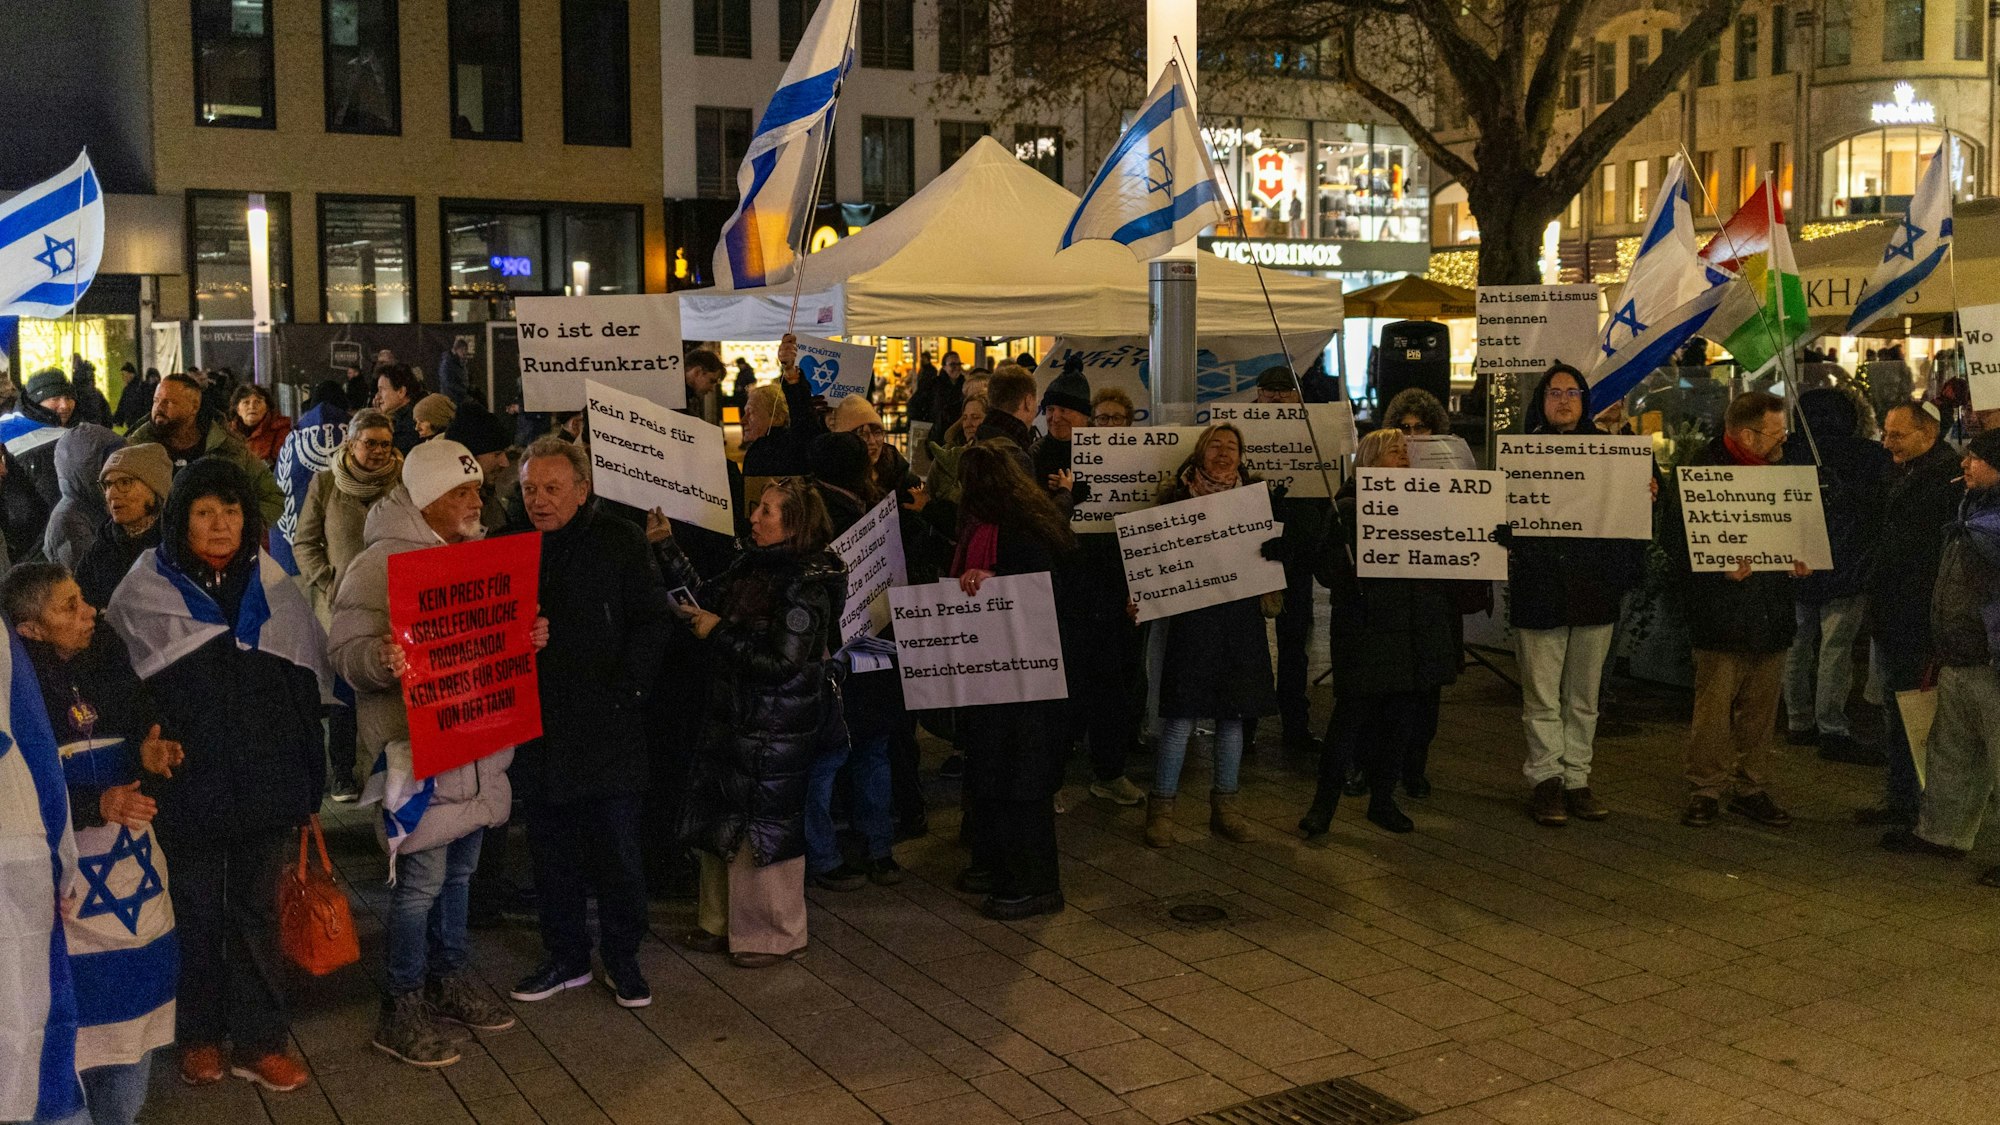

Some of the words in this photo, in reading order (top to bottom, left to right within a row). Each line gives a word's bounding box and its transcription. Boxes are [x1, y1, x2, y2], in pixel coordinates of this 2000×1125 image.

[1211, 241, 1343, 266] VICTORINOX
[1479, 291, 1598, 303] Antisemitismus
[1479, 314, 1548, 325] benennen
[520, 323, 549, 339] Wo
[557, 322, 593, 338] ist
[601, 322, 640, 337] der
[1964, 329, 1993, 345] Wo
[1479, 335, 1522, 346] statt
[808, 346, 842, 359] SCHÜTZEN
[523, 355, 680, 373] Rundfunkrat?
[1479, 357, 1547, 368] belohnen
[1968, 361, 2000, 376] Ru
[831, 381, 866, 393] JÜDISCHES
[588, 398, 625, 421] Kein
[629, 410, 667, 435] Preis
[670, 428, 695, 444] für
[1212, 408, 1237, 420] Ist
[1243, 408, 1271, 420] die
[1276, 409, 1309, 420] ARD
[592, 429, 665, 460] verzerrte
[1073, 433, 1102, 446] Ist
[1108, 433, 1137, 446] die
[1143, 432, 1179, 446] ARD
[1500, 442, 1652, 456] Antisemitismus
[1073, 452, 1104, 465] die
[594, 454, 728, 510] Berichterstattung
[1681, 468, 1734, 482] Keine
[1361, 476, 1396, 491] Ist
[1404, 478, 1440, 492] die
[1449, 479, 1492, 494] ARD
[1506, 492, 1551, 504] tatt
[1684, 489, 1776, 506] Belohnung
[1783, 489, 1813, 502] für
[1362, 501, 1399, 516] die
[1688, 510, 1792, 523] Aktivismus
[1118, 511, 1207, 539] Einseitige
[1506, 517, 1583, 531] elohnen
[1123, 519, 1274, 561] Berichterstattung
[1362, 525, 1498, 543] Pressestelle
[1691, 531, 1711, 544] in
[1718, 530, 1748, 544] der
[1363, 549, 1399, 564] der
[1408, 550, 1480, 567] Hamas?
[1693, 552, 1795, 568] Tagesschau
[864, 555, 888, 583] nicht
[1128, 567, 1154, 582] ist
[1158, 559, 1195, 576] kein
[418, 586, 447, 612] KEIN
[450, 579, 485, 604] PREIS
[488, 573, 511, 598] FÜR
[1132, 572, 1238, 603] Journalismus
[894, 605, 932, 620] Kein
[936, 601, 981, 617] Preis
[986, 598, 1014, 612] für
[411, 600, 519, 645] ISRAELFEINDLICHE
[900, 631, 979, 649] verzerrte
[429, 631, 506, 672] PROPAGANDA!
[903, 657, 1059, 679] Berichterstattung
[409, 682, 437, 709] KEIN
[439, 671, 471, 700] PREIS
[472, 660, 493, 687] FÜR
[495, 653, 532, 683] SOPHIE
[436, 705, 460, 731] VON
[462, 697, 483, 723] DER
